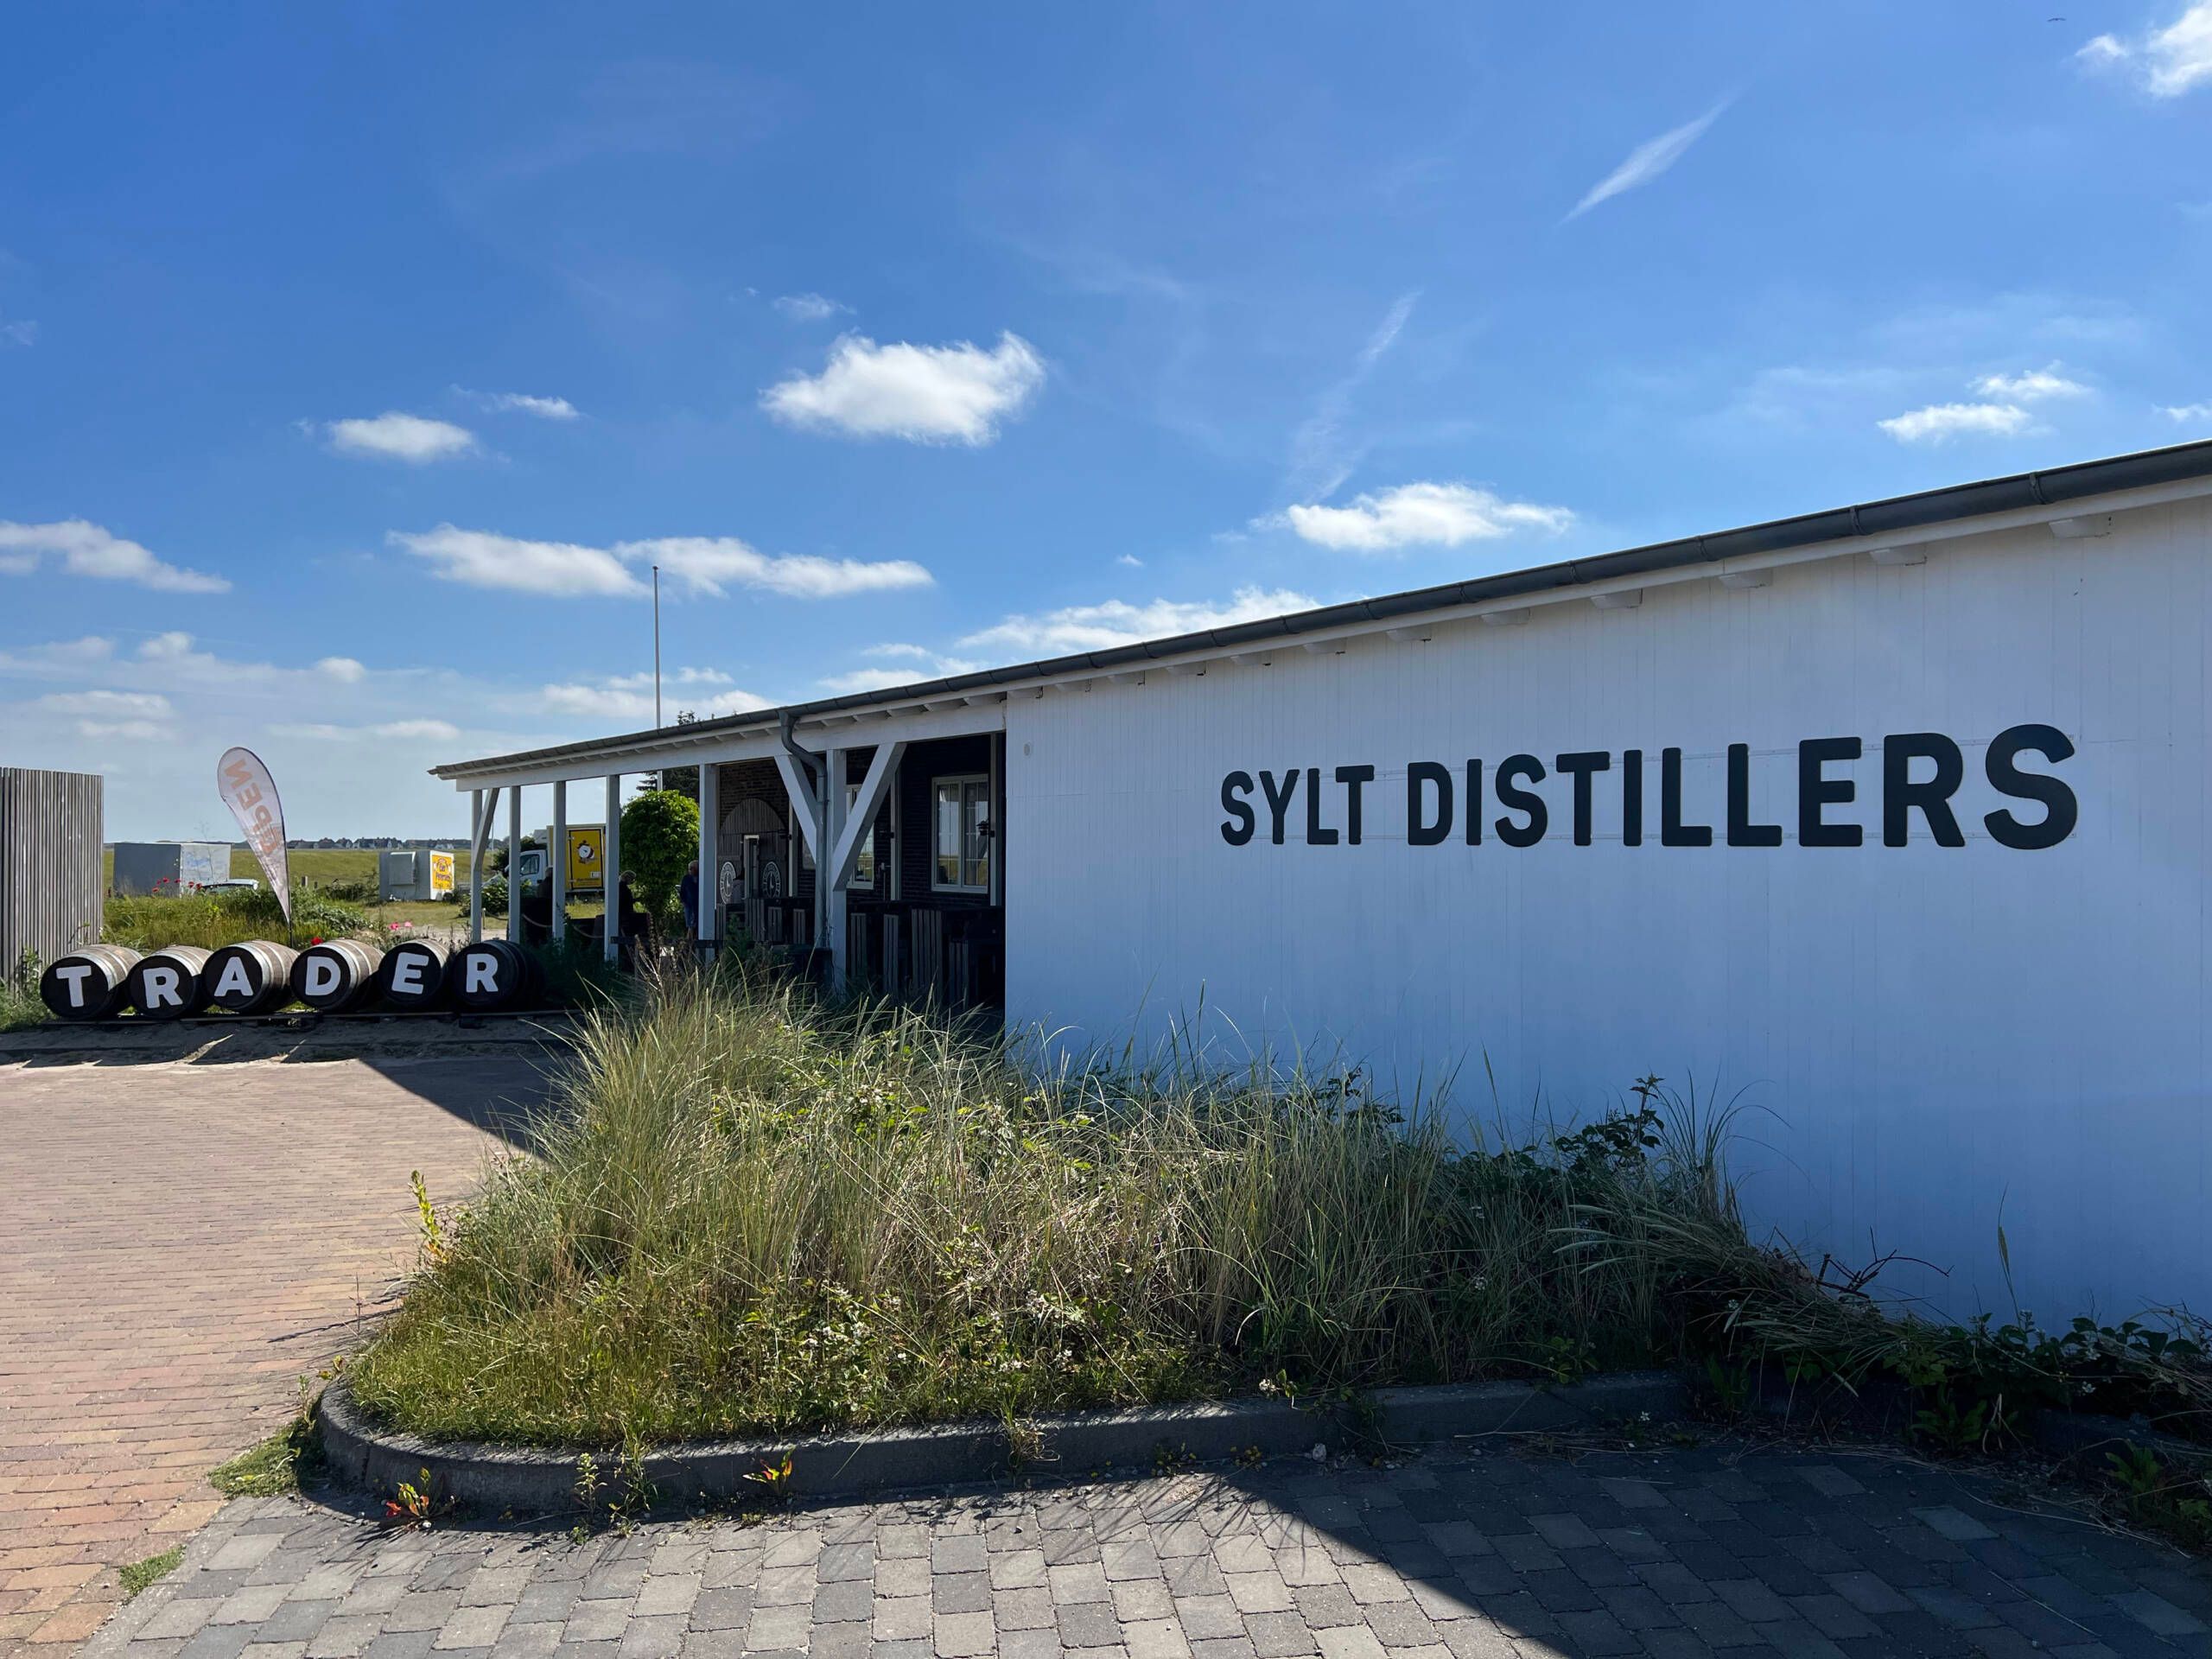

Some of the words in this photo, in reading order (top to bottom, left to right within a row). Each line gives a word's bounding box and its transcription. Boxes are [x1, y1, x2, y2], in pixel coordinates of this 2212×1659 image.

[1220, 765, 1375, 846] SYLT
[1407, 723, 2077, 850] DISTILLERS
[55, 951, 499, 1008] TRADER
